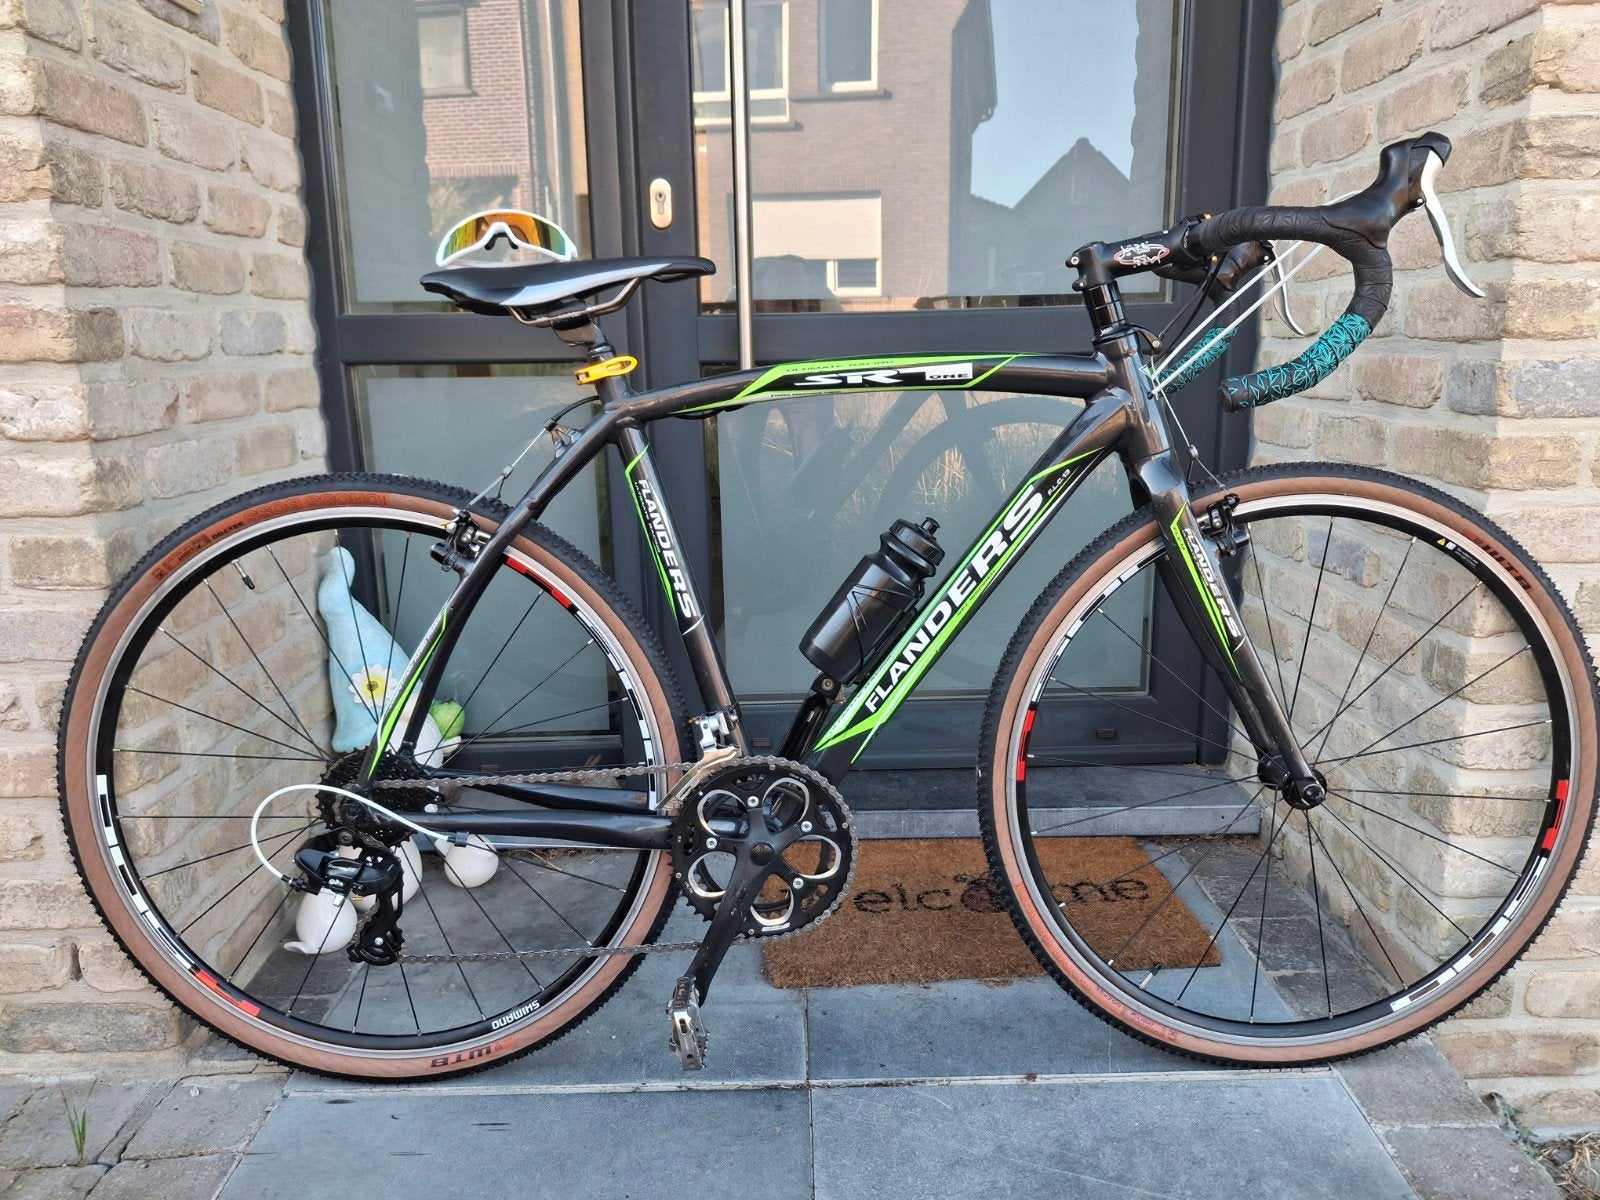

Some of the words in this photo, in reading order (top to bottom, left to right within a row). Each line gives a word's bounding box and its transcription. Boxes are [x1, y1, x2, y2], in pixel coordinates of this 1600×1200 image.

[786, 364, 844, 372] ULTIMATE
[242, 498, 301, 520] BOSS
[305, 492, 381, 506] CROSS
[638, 479, 698, 619] FLANDERS
[1183, 528, 1243, 638] FLANDERS
[864, 485, 1043, 714] FLANDERS
[491, 999, 541, 1030] SHIMANO
[430, 1044, 493, 1068] WTB
